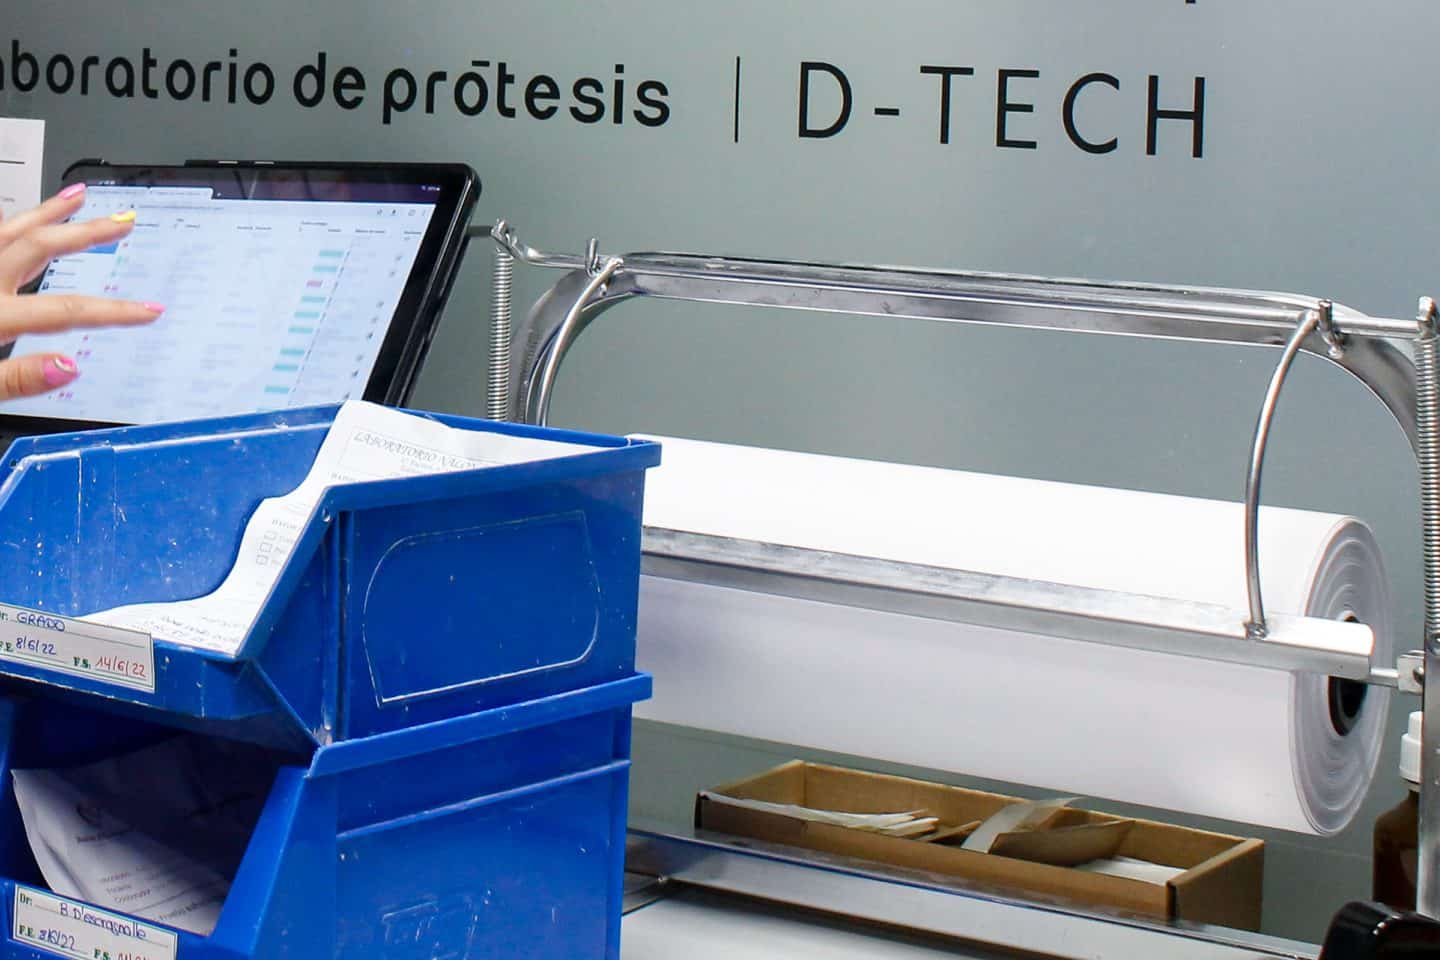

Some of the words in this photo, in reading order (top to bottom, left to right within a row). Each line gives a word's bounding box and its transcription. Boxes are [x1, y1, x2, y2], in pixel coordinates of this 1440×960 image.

[293, 52, 365, 109] de
[798, 61, 1204, 157] D-TECH
[15, 635, 57, 656] 8/6/22
[95, 654, 147, 678] 14/6/22
